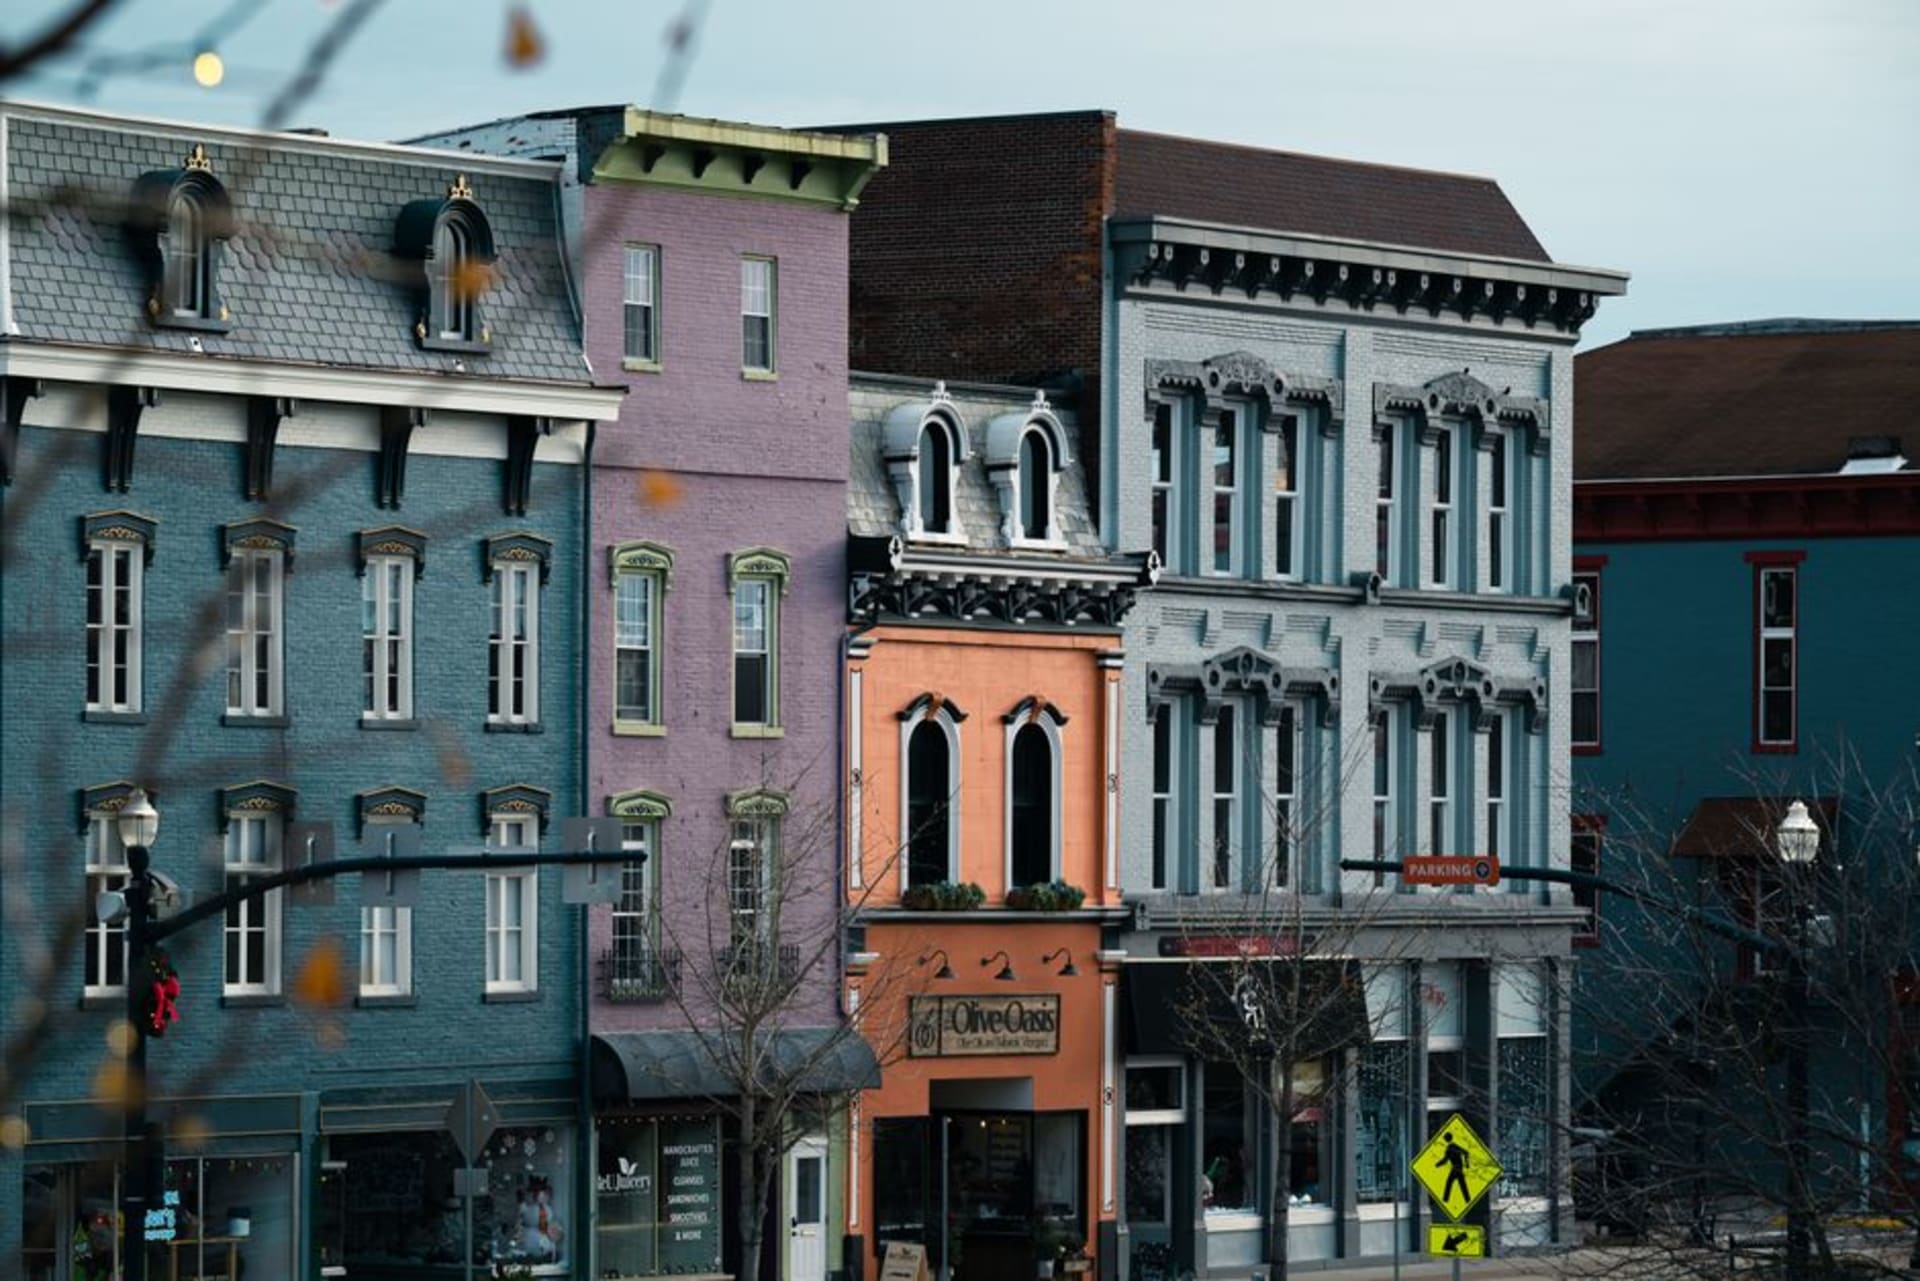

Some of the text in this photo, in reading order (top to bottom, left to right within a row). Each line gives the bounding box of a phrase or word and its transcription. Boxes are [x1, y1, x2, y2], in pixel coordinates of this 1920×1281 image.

[1409, 863, 1472, 876] PARKING
[952, 1001, 1002, 1033] Olive
[1006, 1001, 1054, 1032] Oasis
[664, 1145, 714, 1154] HANDCRAFTED
[683, 1231, 701, 1240] MORE
